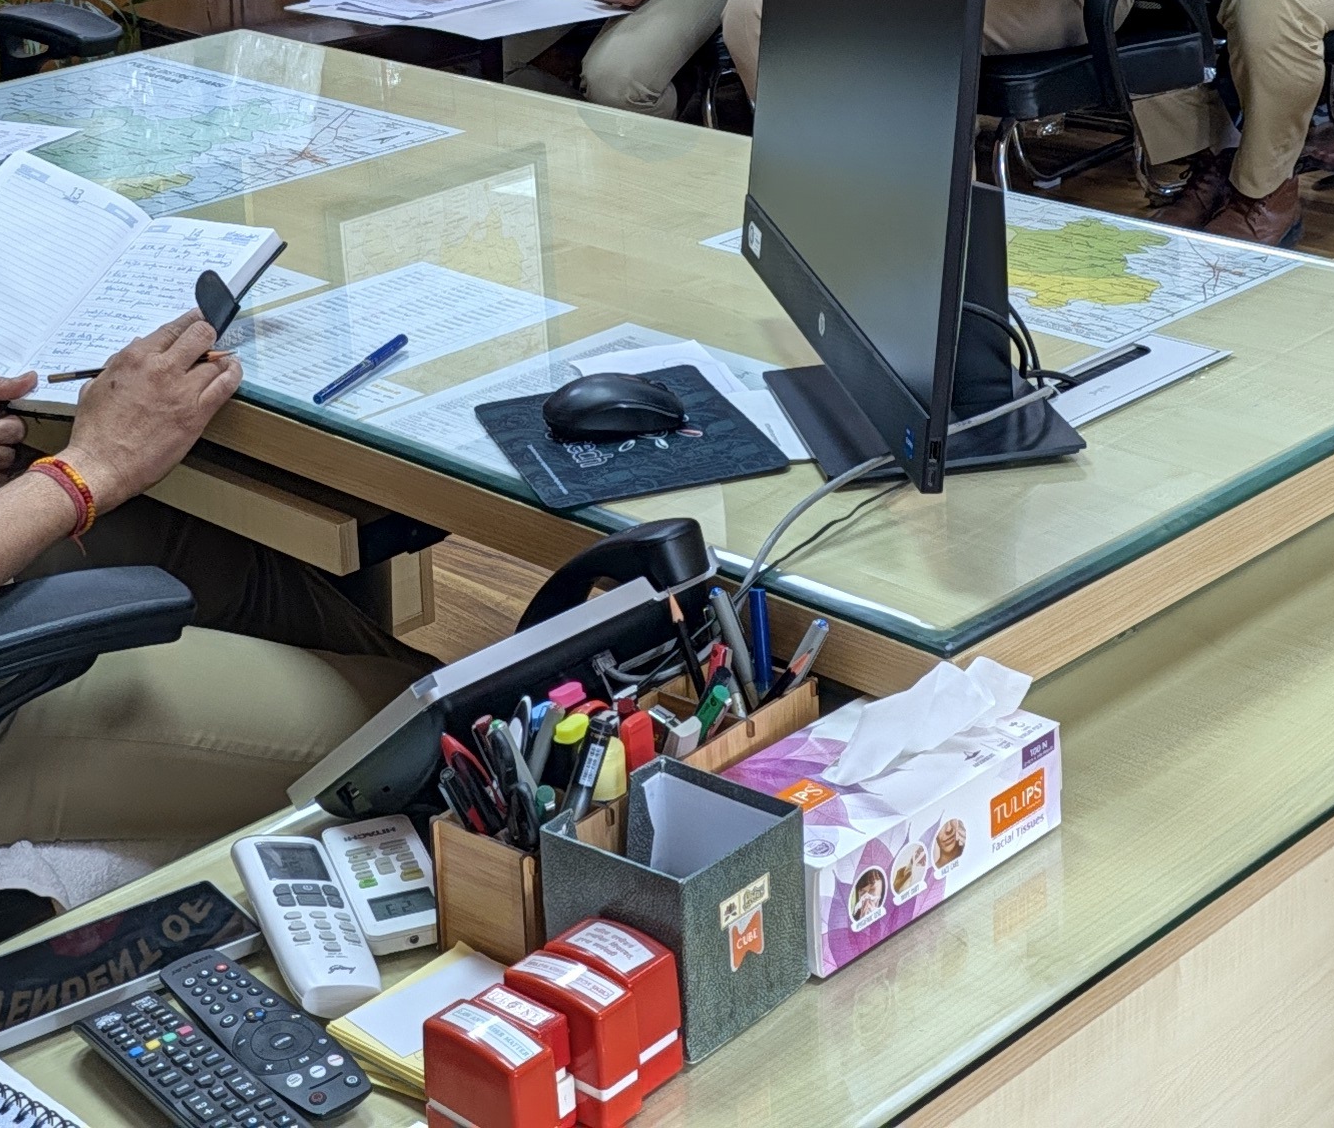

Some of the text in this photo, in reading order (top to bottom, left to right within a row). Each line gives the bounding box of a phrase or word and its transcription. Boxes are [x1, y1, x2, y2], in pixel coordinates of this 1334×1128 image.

[69, 186, 85, 201] 13
[993, 779, 1043, 824] TULIPS
[344, 826, 395, 842] HITACHI
[991, 814, 1045, 853] Facial Tissues
